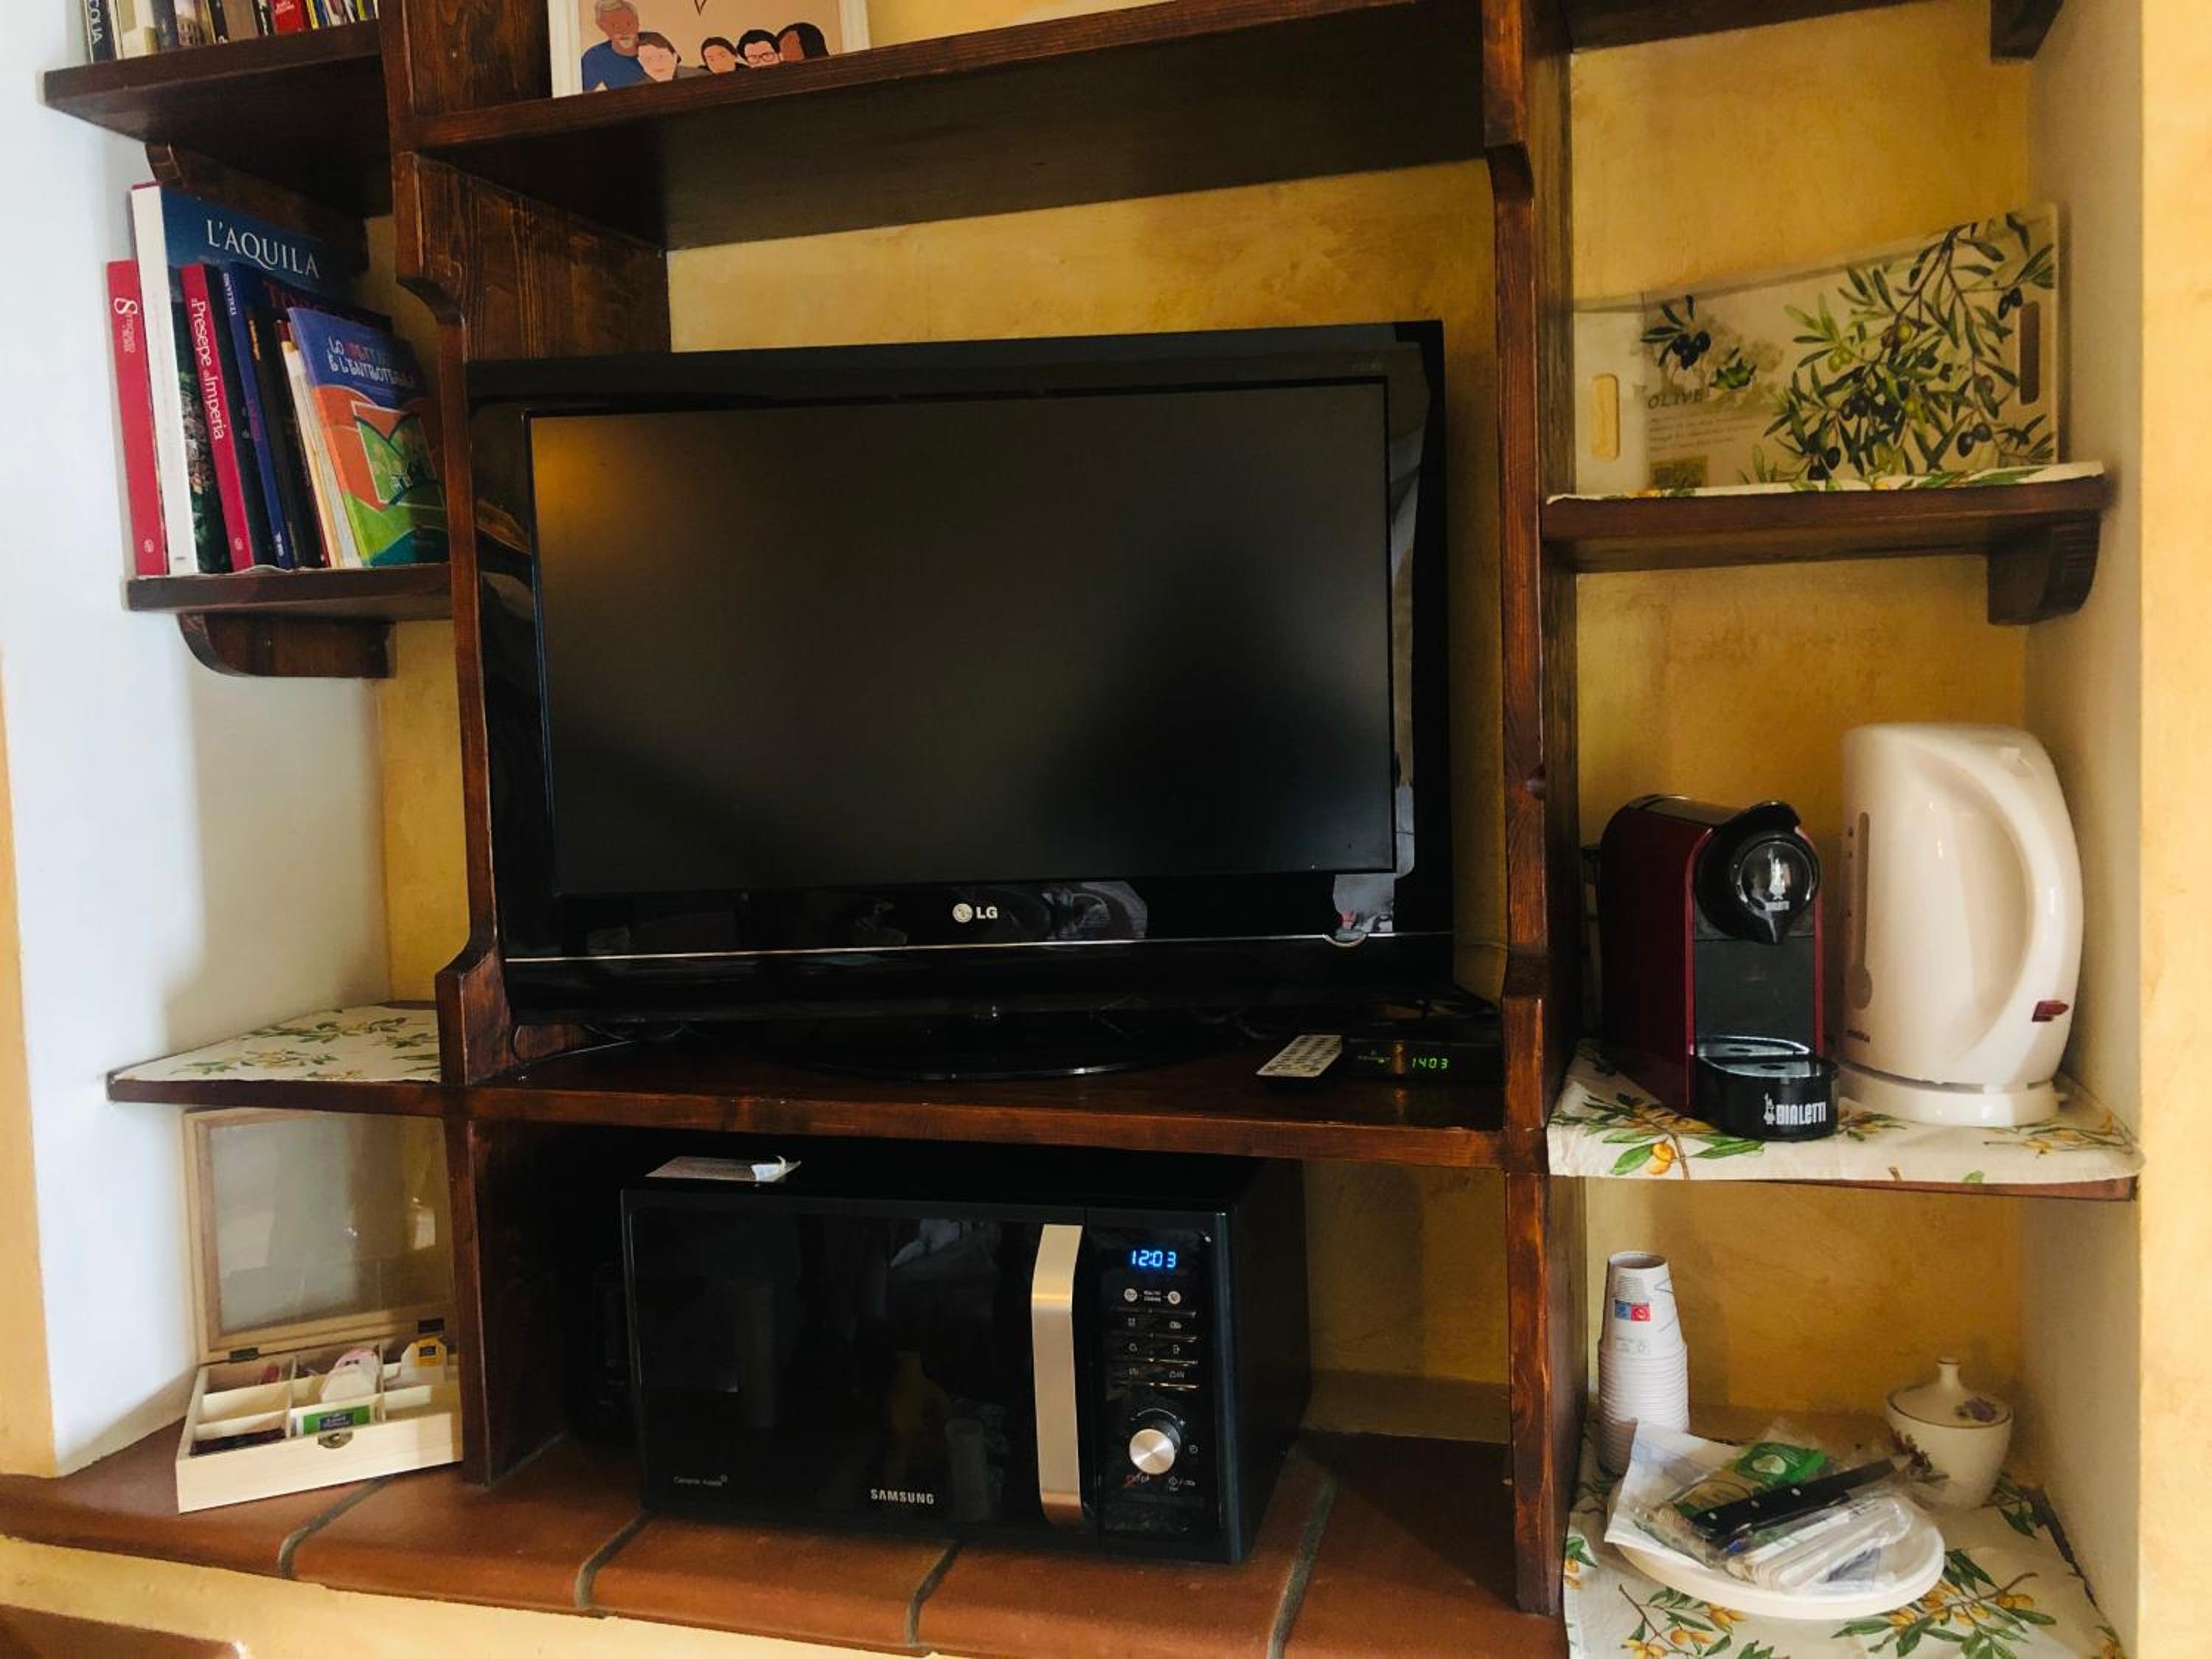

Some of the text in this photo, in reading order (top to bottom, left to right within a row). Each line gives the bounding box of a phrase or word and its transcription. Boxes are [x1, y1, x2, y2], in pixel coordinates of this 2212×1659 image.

[206, 219, 319, 279] L'AQUILA
[192, 301, 212, 366] Presepe
[204, 376, 226, 439] Imperia
[1648, 389, 1703, 408] OLIVE
[975, 906, 998, 919] LG
[1412, 1057, 1448, 1069] 1403
[1132, 1250, 1176, 1267] 12:03
[871, 1489, 933, 1504] SAMSUNG
